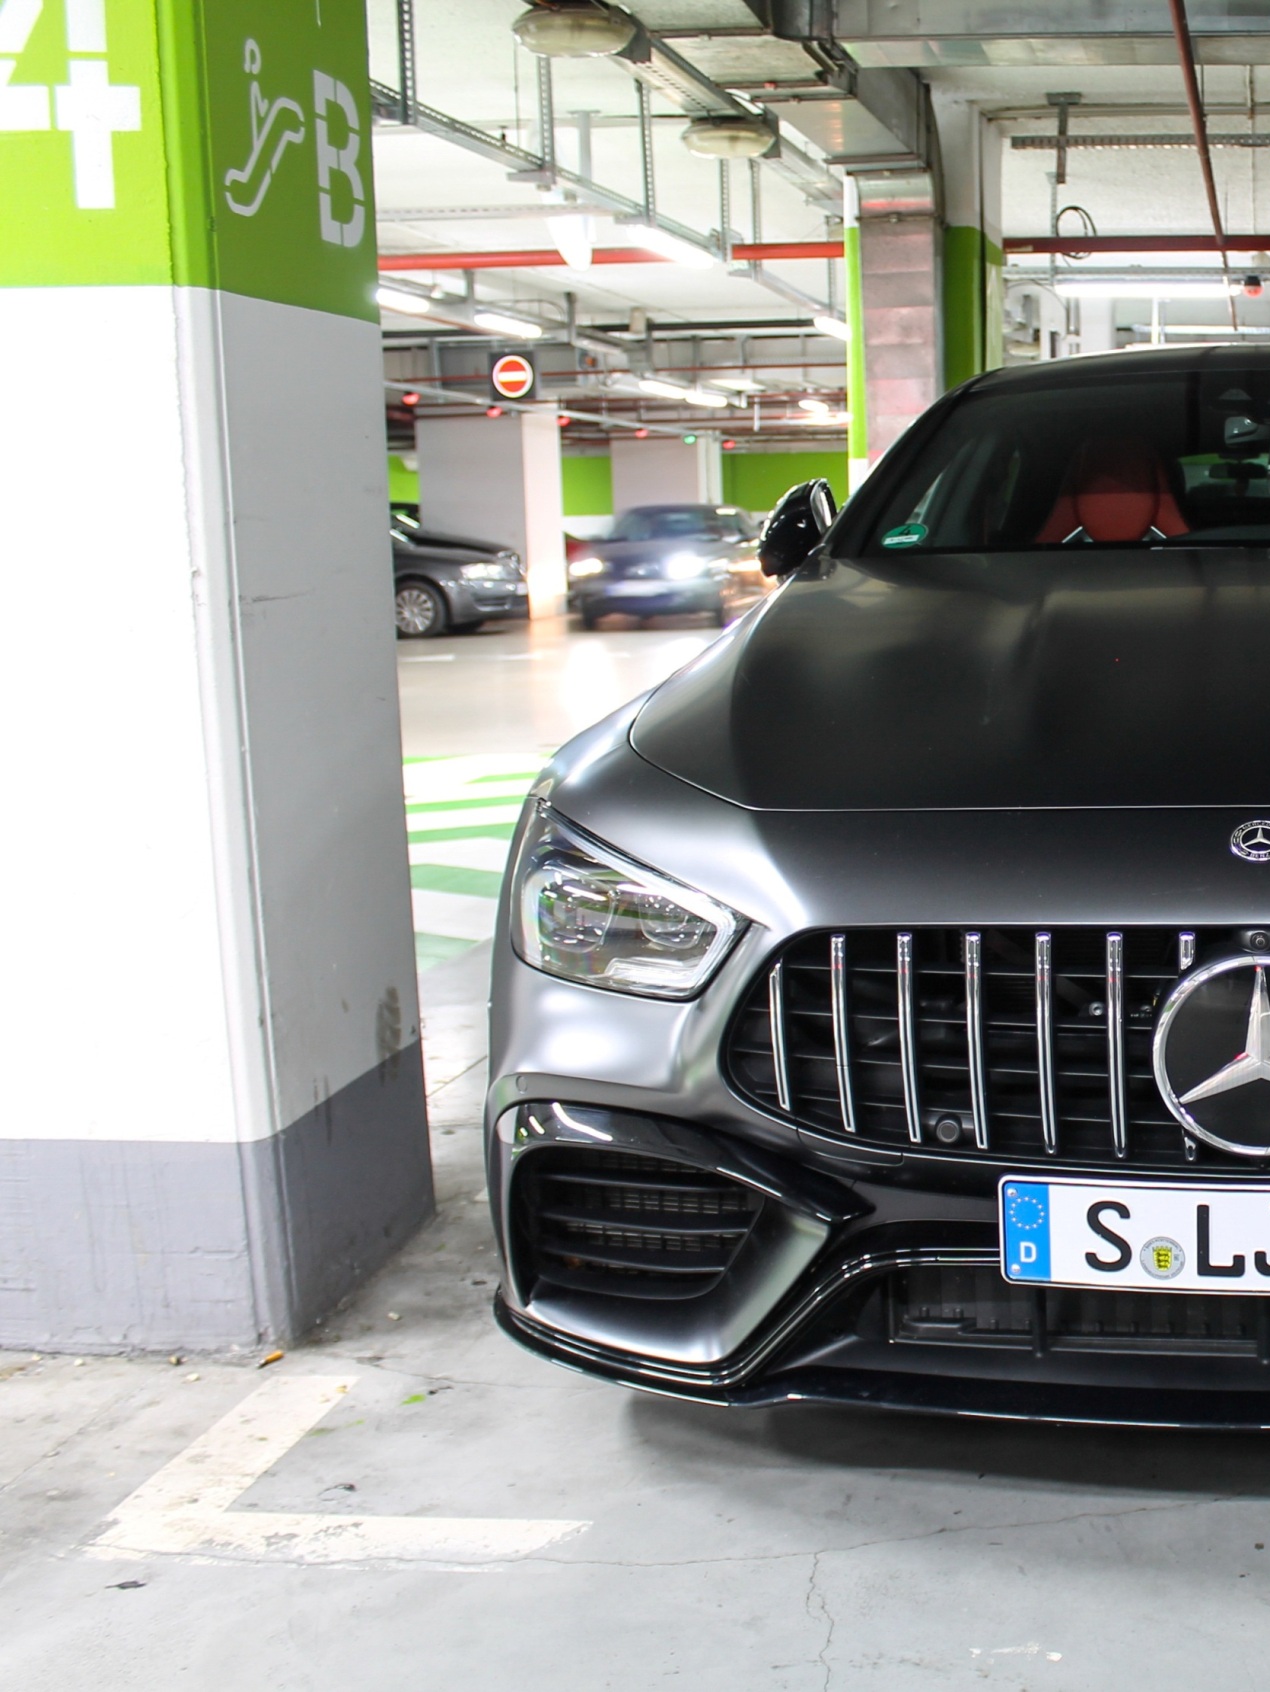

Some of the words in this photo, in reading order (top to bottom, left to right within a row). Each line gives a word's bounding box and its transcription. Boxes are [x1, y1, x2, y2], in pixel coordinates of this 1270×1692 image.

[312, 69, 366, 249] B
[1019, 1241, 1037, 1263] D
[1085, 1201, 1133, 1272] S
